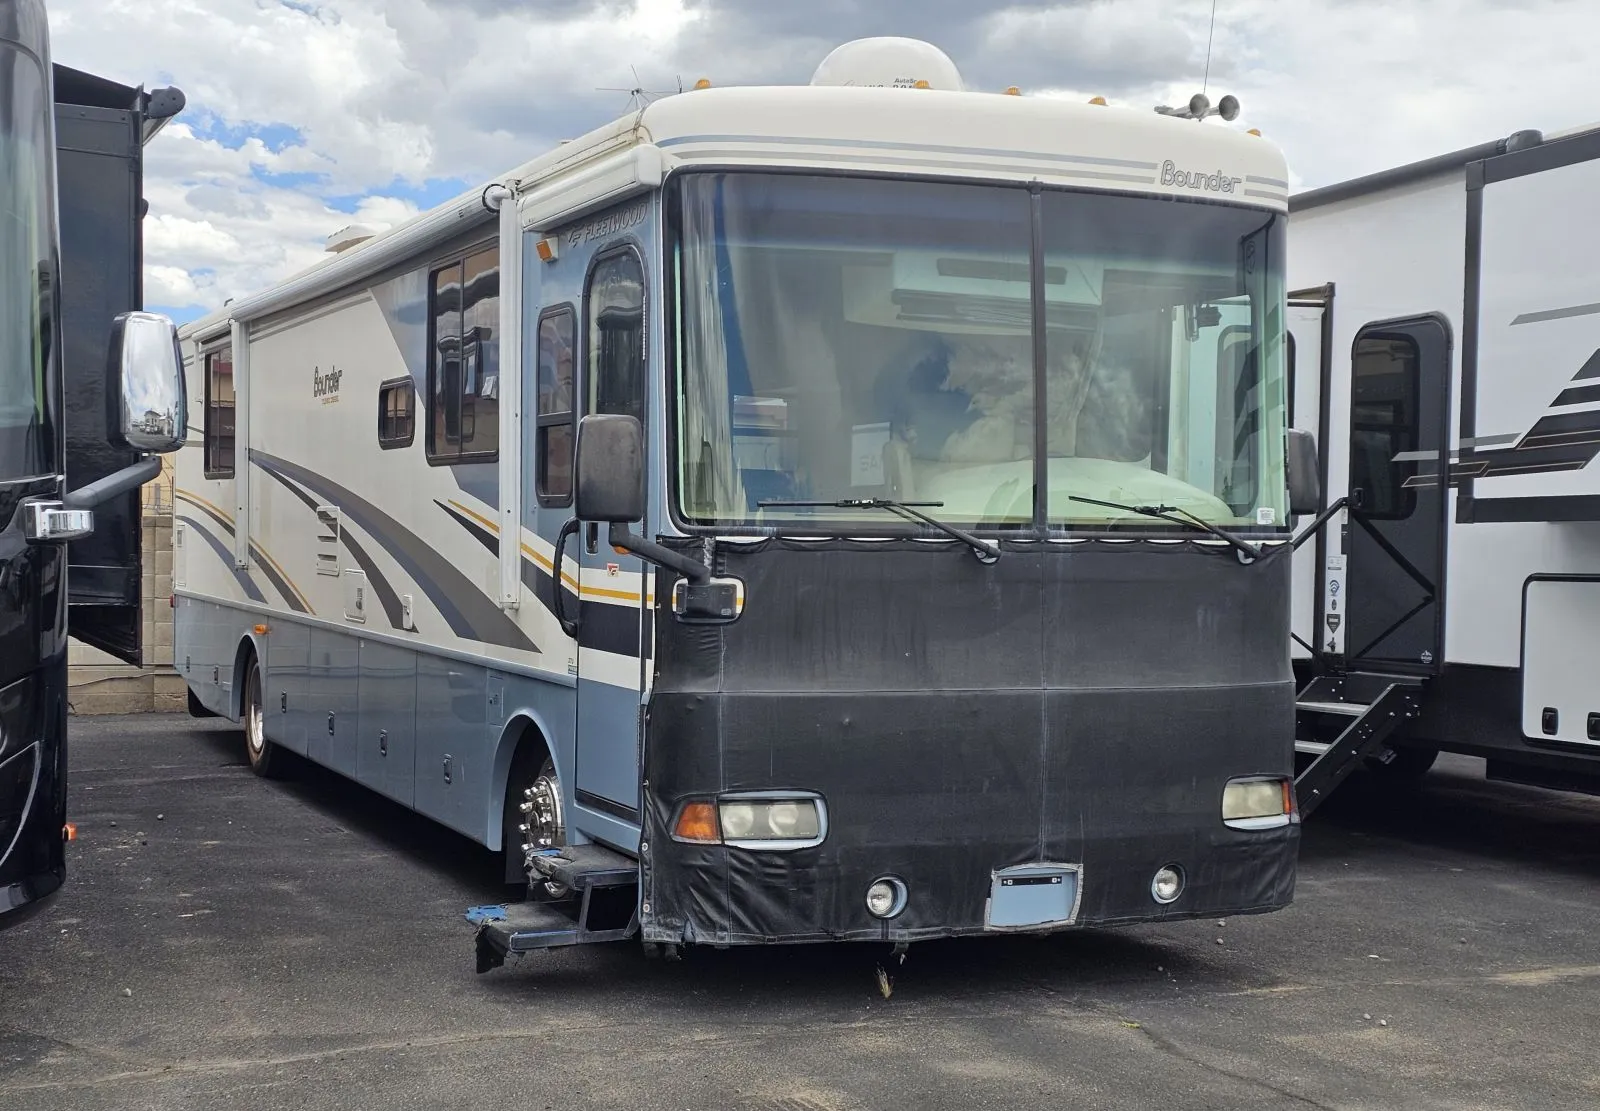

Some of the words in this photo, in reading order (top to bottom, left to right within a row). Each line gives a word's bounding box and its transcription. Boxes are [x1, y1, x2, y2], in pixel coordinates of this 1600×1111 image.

[1160, 159, 1242, 194] Bounder
[584, 202, 648, 244] FLEETWOOD
[313, 365, 343, 398] Bounder
